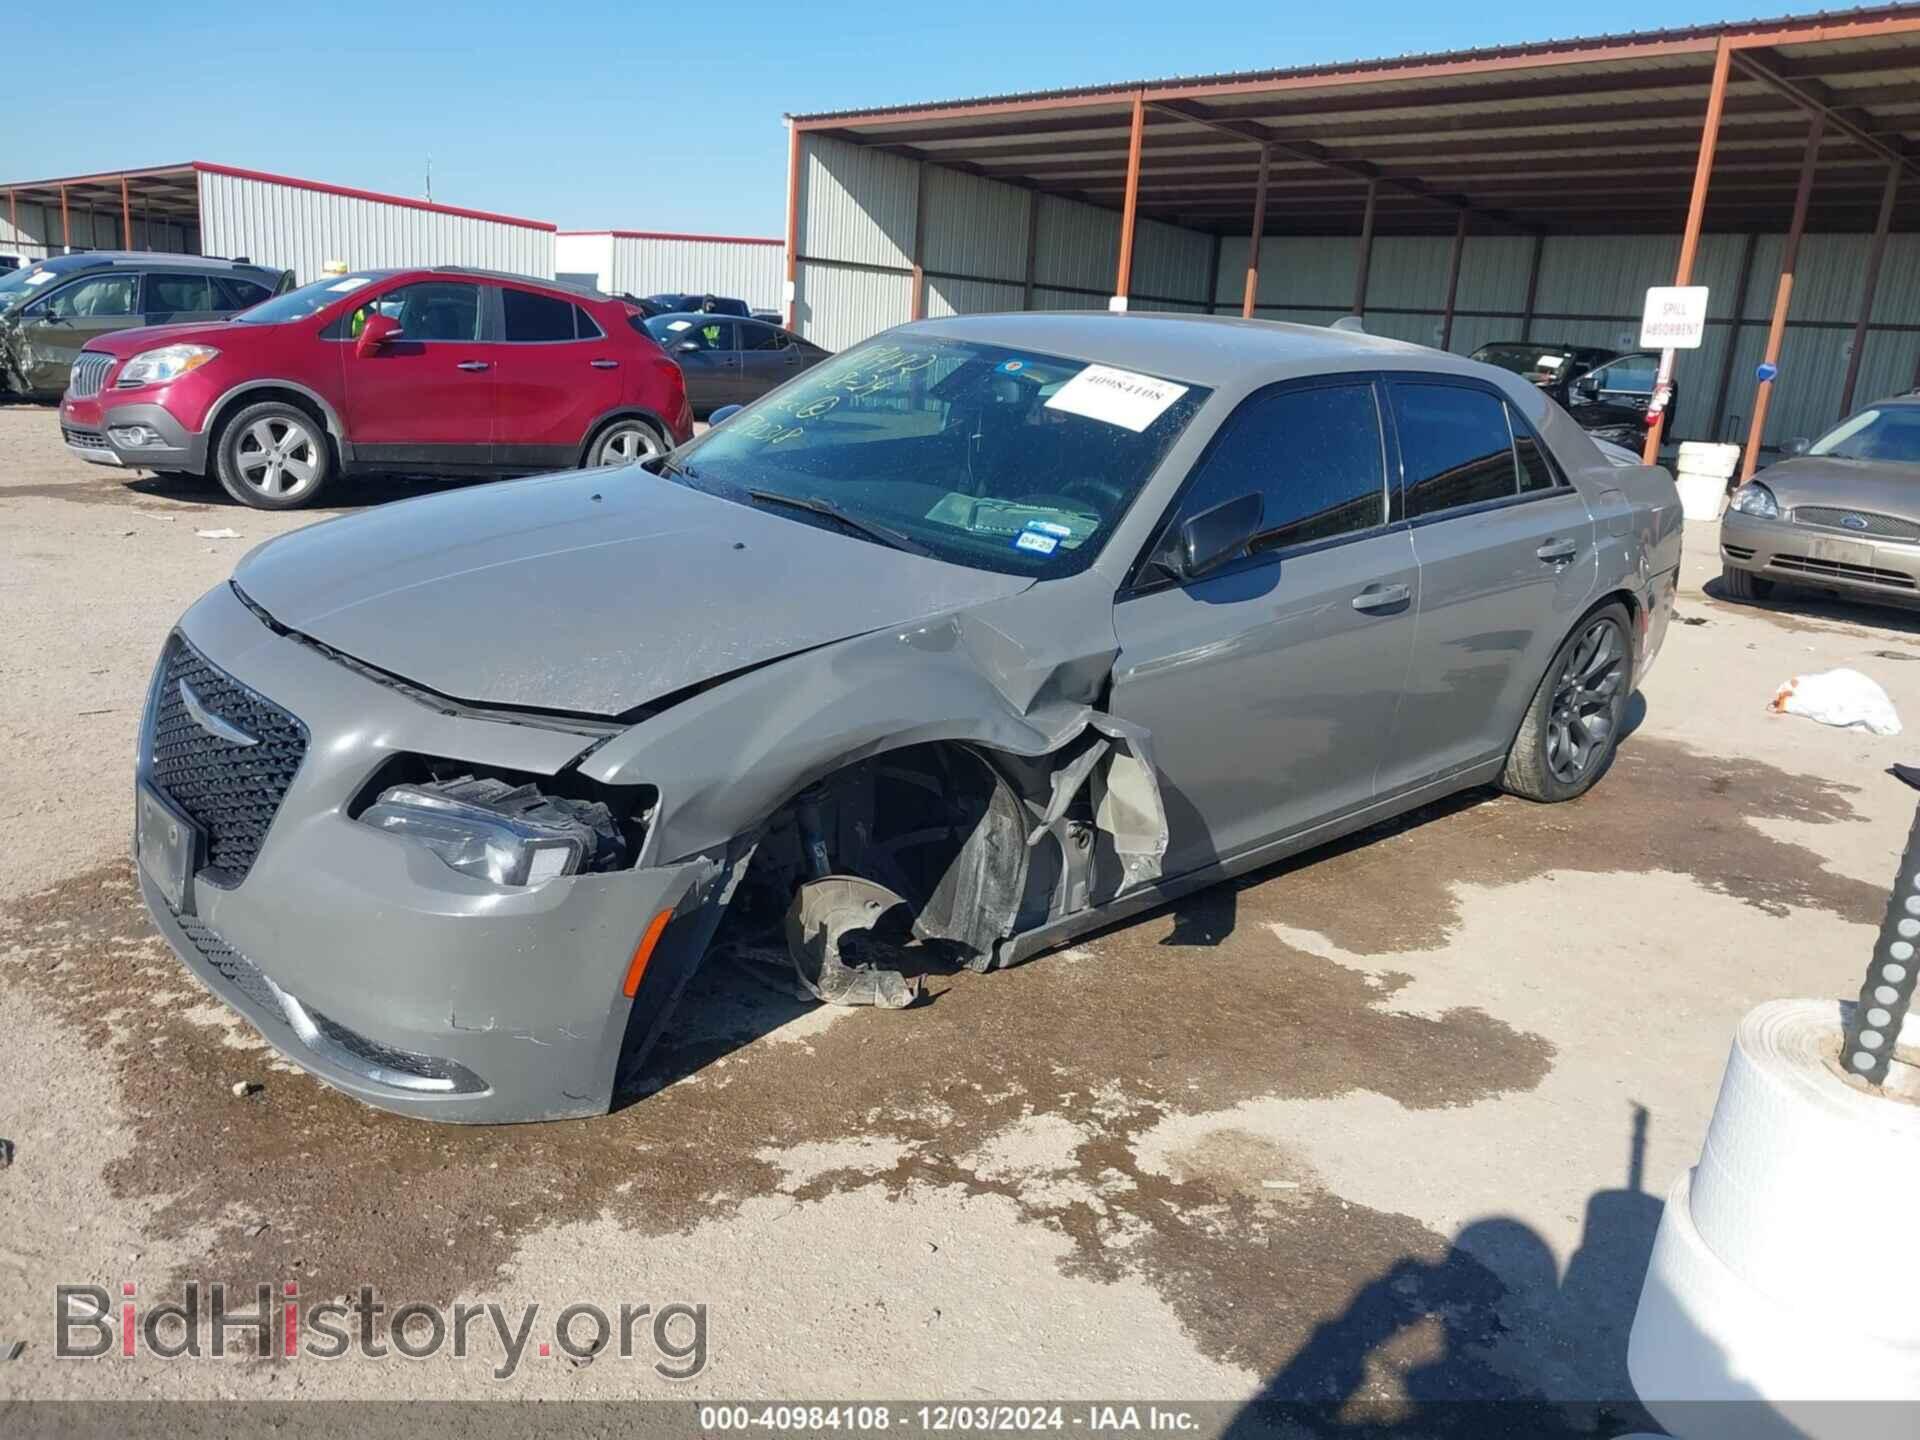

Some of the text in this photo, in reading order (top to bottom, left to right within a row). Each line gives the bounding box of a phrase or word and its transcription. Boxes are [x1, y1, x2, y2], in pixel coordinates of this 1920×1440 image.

[1663, 302, 1687, 316] SPILL
[1645, 321, 1701, 336] ABSORBENT
[1086, 374, 1165, 401] 40984108
